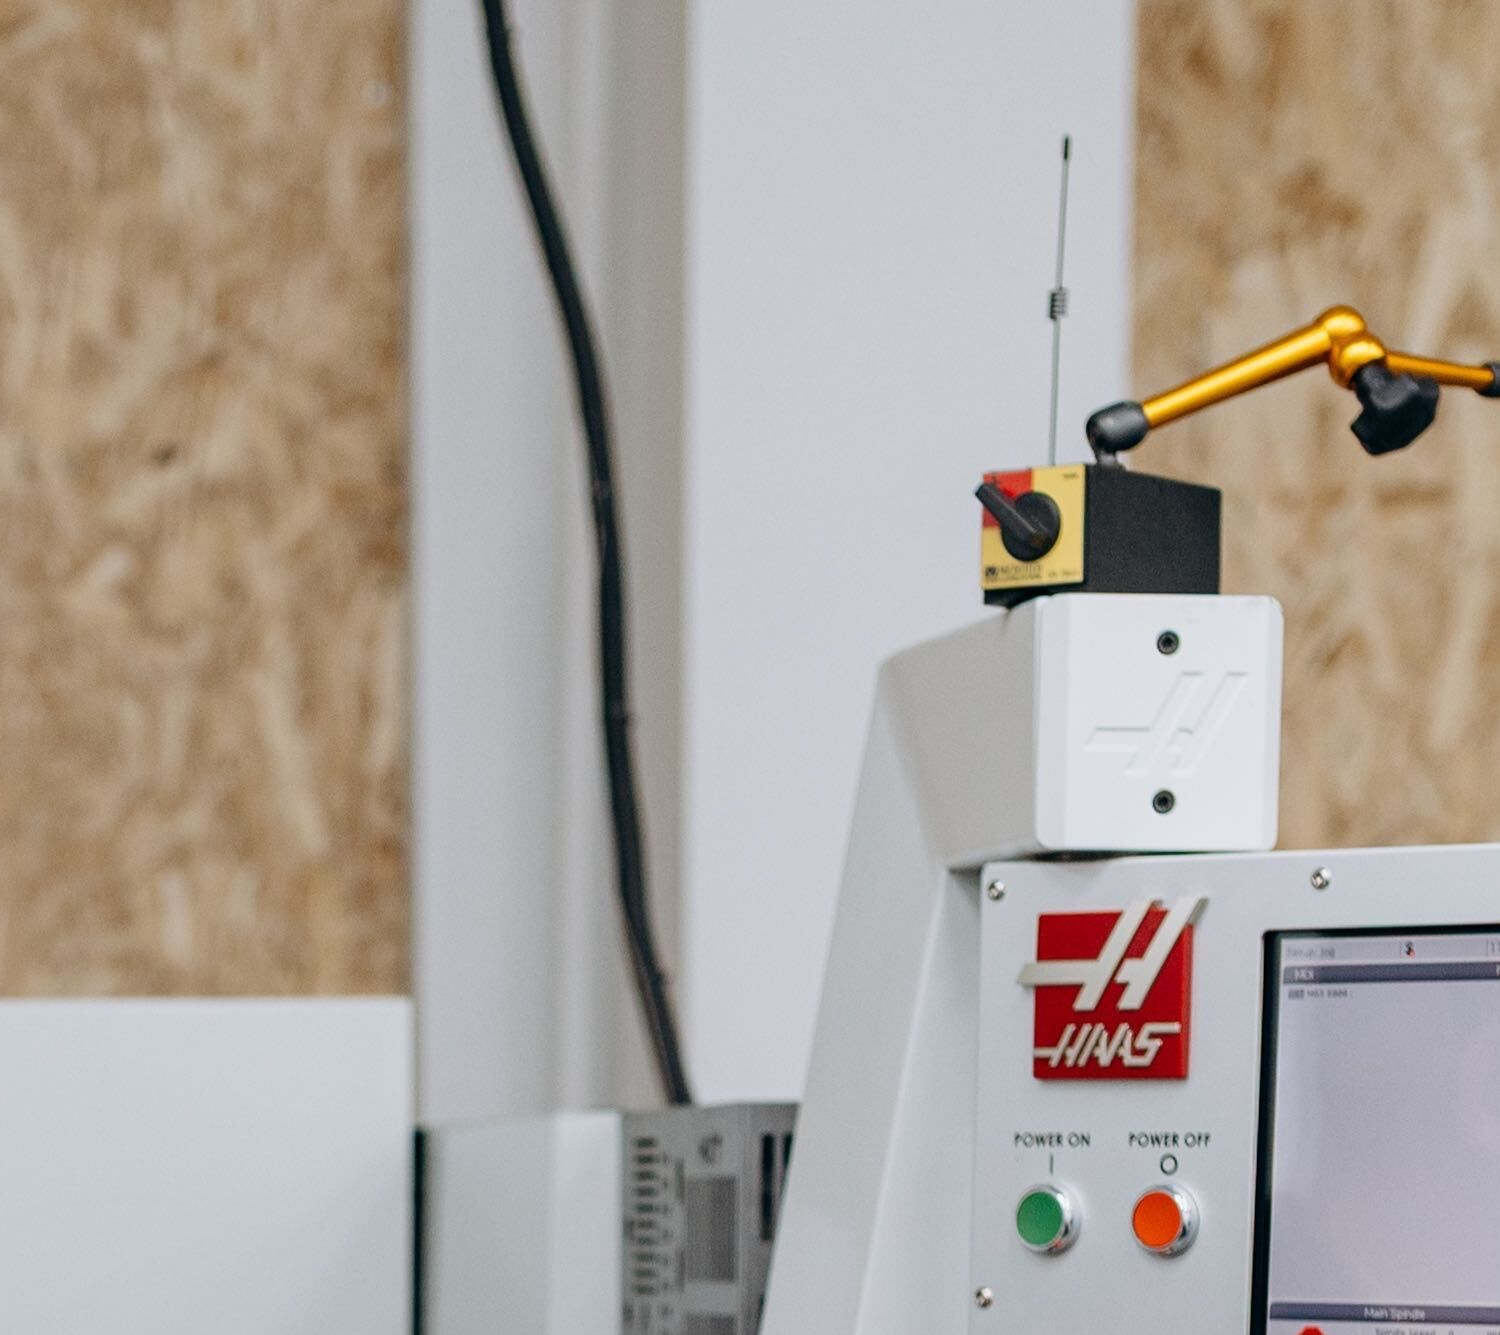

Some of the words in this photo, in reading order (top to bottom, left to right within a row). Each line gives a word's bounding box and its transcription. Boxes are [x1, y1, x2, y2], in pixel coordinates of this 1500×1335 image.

[1034, 1022, 1181, 1067] HAAS
[1014, 1132, 1063, 1147] POWER
[1068, 1132, 1091, 1147] ON
[1128, 1132, 1179, 1147] POWER
[1184, 1132, 1211, 1147] OFF
